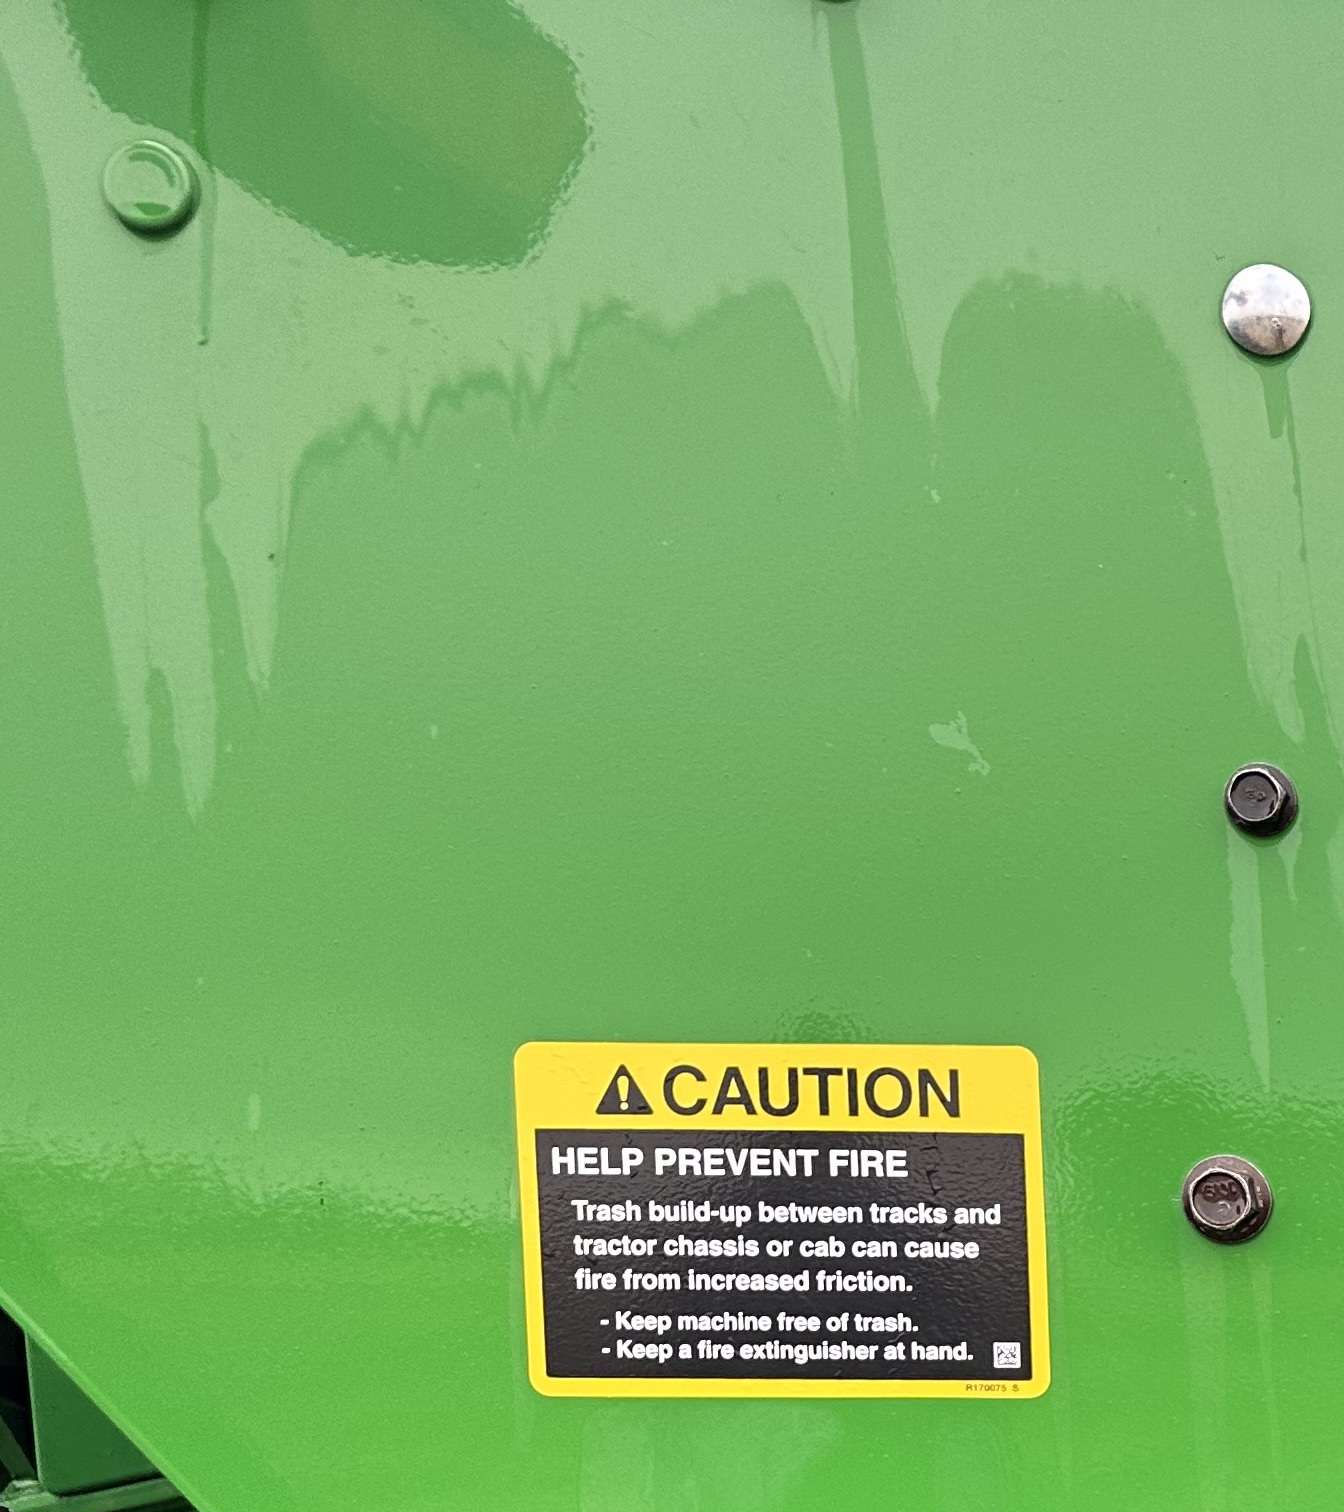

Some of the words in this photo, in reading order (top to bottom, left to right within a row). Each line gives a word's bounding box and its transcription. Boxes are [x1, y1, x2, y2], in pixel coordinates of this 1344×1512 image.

[663, 1065, 961, 1118] CAUTION
[551, 1146, 645, 1176] HELP
[654, 1147, 819, 1177] PREVENT
[829, 1149, 908, 1178] FIRE
[571, 1199, 642, 1222] Trash
[648, 1200, 752, 1227] build-up
[758, 1201, 863, 1224] between
[869, 1203, 948, 1225] tracks
[954, 1203, 1001, 1225] and
[573, 1234, 657, 1256] tractor
[663, 1234, 760, 1257] chassis
[765, 1240, 793, 1257] or
[799, 1236, 846, 1258] cab
[851, 1241, 898, 1258] can
[904, 1241, 980, 1258] cause
[574, 1268, 617, 1290] fire
[622, 1268, 681, 1290] from
[688, 1269, 810, 1291] increased
[816, 1270, 913, 1292] friction.
[615, 1310, 672, 1335] Keep
[677, 1311, 772, 1331] machine
[776, 1312, 821, 1331] free
[826, 1312, 850, 1332] of
[854, 1312, 919, 1333] trash.
[616, 1339, 673, 1364] Keep
[678, 1343, 693, 1360] a
[696, 1339, 735, 1360] fire
[739, 1339, 879, 1365] extinguisher
[883, 1342, 907, 1361] at
[911, 1341, 974, 1361] hand.
